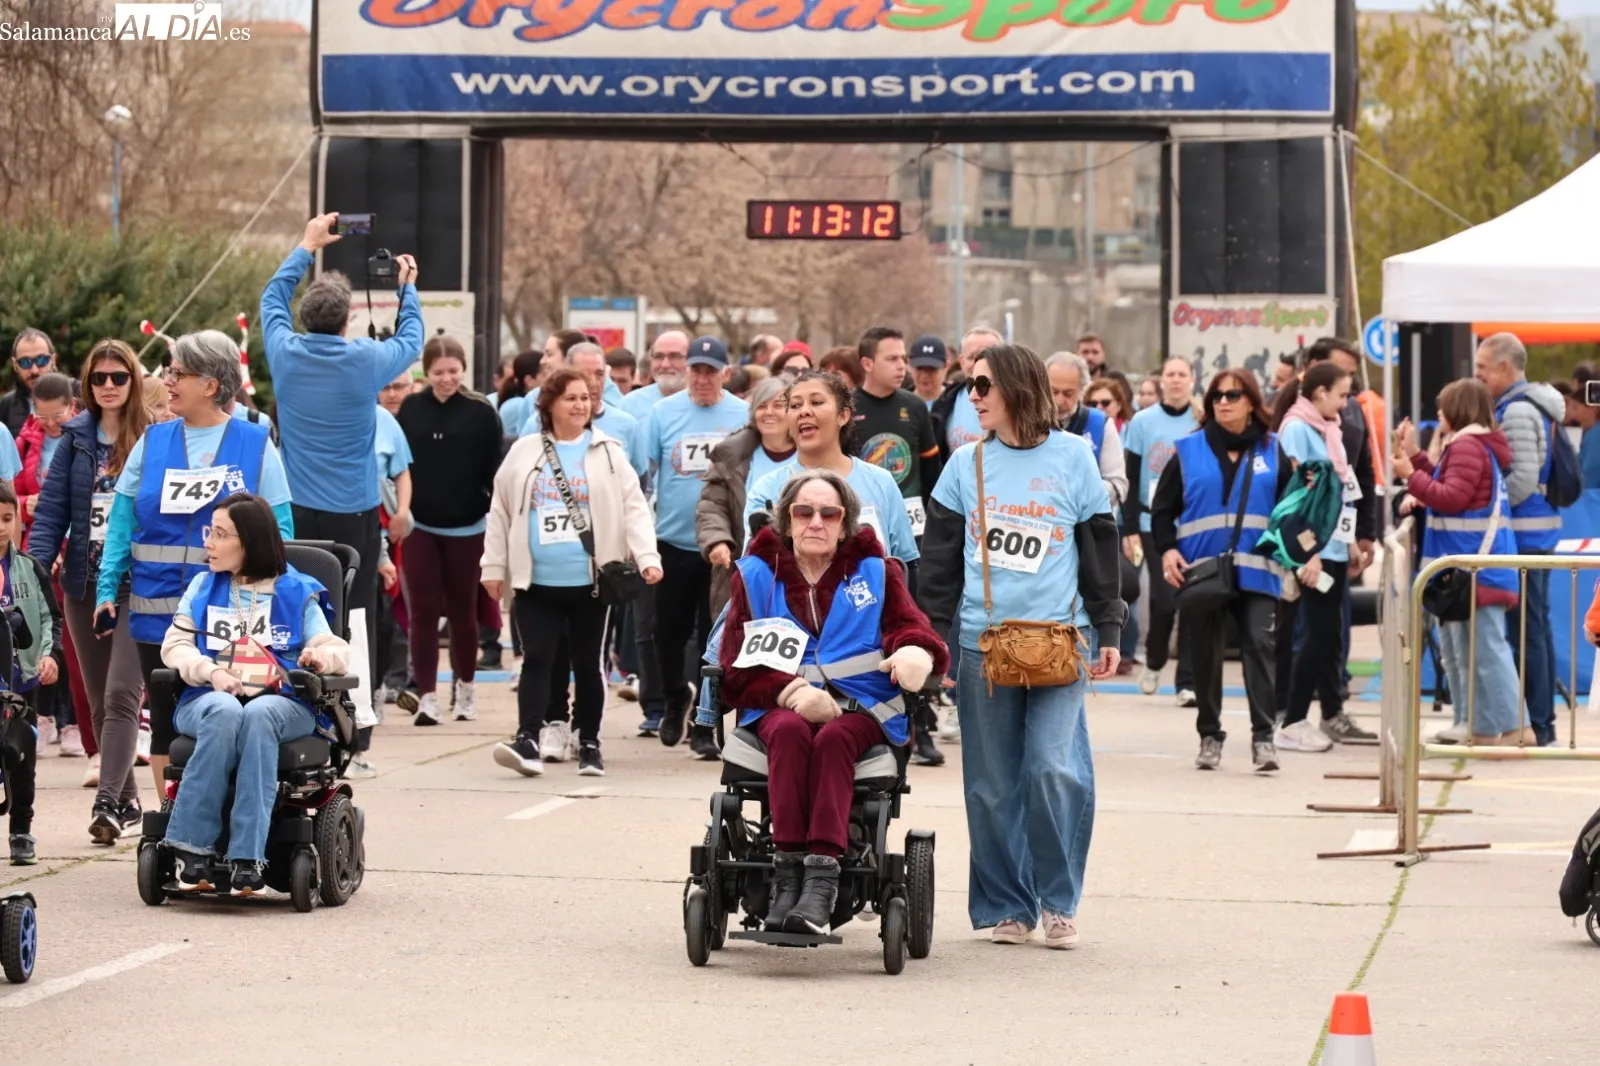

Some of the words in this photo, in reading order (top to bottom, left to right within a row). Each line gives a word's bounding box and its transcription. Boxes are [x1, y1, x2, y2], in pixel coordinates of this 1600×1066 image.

[451, 67, 1195, 104] www.orycronsport.com
[763, 203, 895, 237] 11:13:12
[169, 479, 220, 501] 743
[543, 514, 571, 533] 57
[986, 527, 1043, 560] 600
[745, 631, 800, 660] 606
